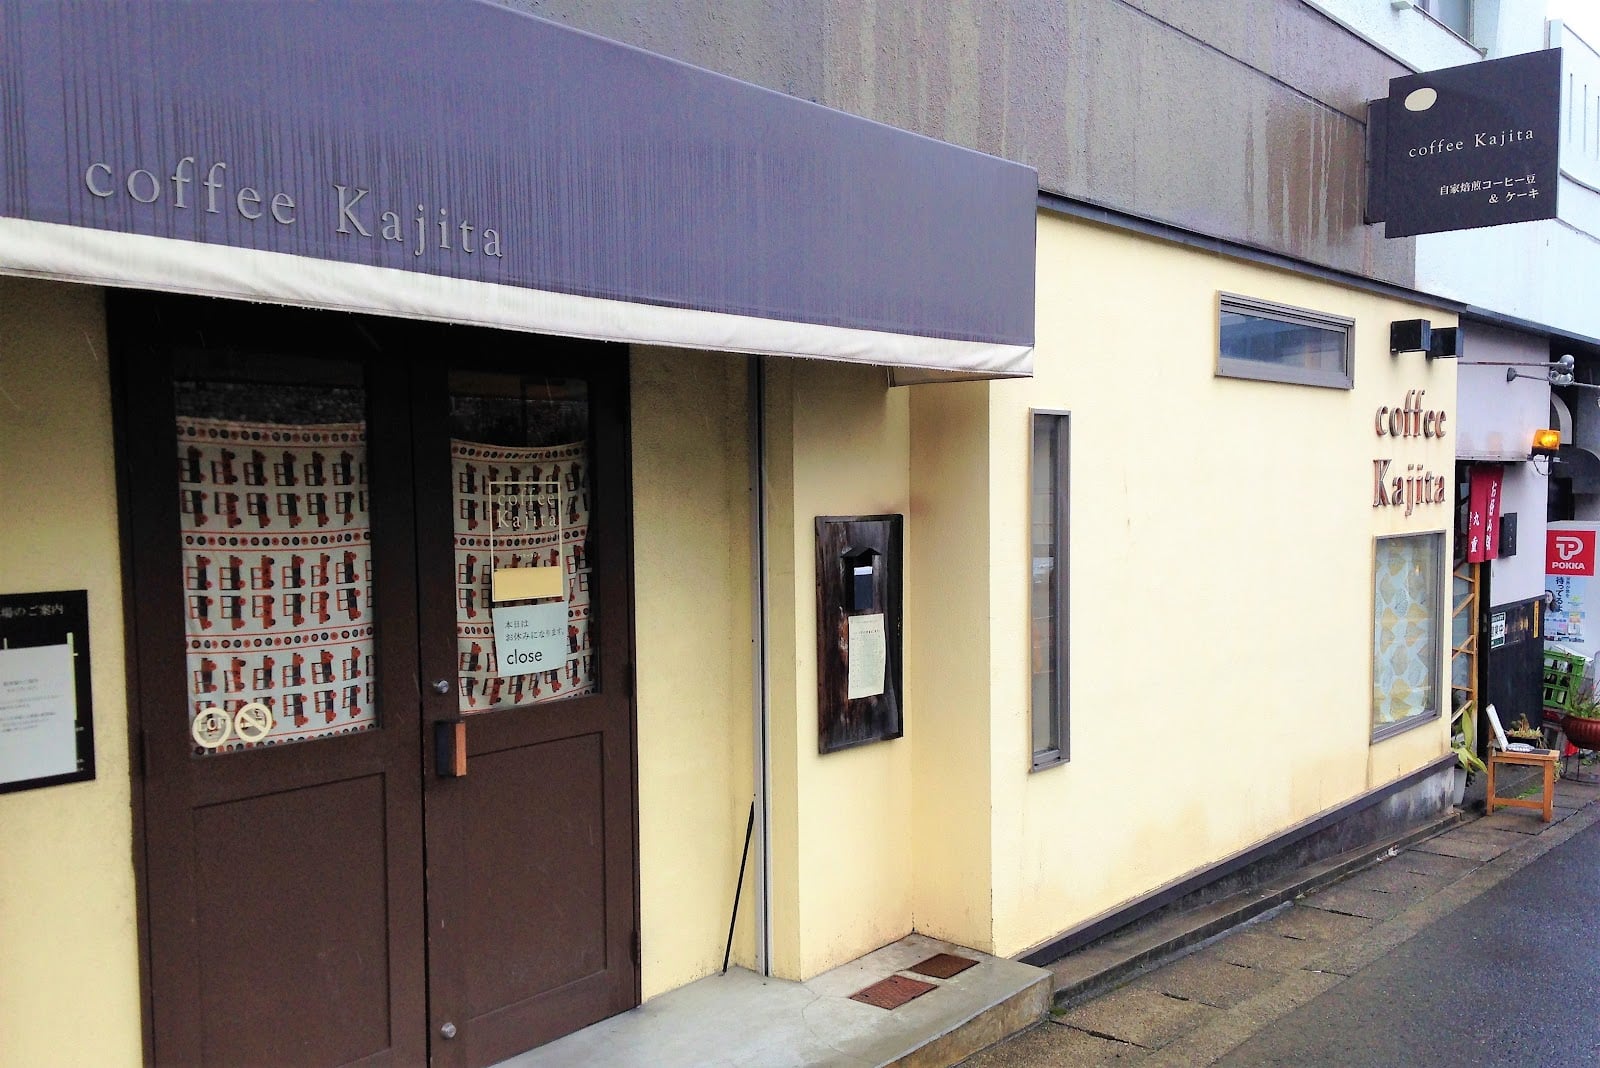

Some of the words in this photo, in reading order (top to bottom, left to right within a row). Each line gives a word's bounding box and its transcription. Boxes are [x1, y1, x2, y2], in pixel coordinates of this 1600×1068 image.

[1409, 139, 1464, 158] coffee
[1475, 130, 1534, 148] Kajita
[1439, 173, 1536, 196] 自家焙煎コーヒー豆
[1489, 194, 1499, 204] &
[1506, 188, 1539, 203] ケーキ
[85, 157, 297, 224] coffee
[334, 184, 504, 258] Kajita
[1375, 389, 1447, 438] coffee
[498, 487, 555, 506] coffee
[1373, 459, 1446, 517] Kajita
[497, 510, 557, 531] Kajita
[1552, 562, 1586, 570] POKKA
[505, 620, 529, 629] 本日は
[507, 649, 543, 665] close
